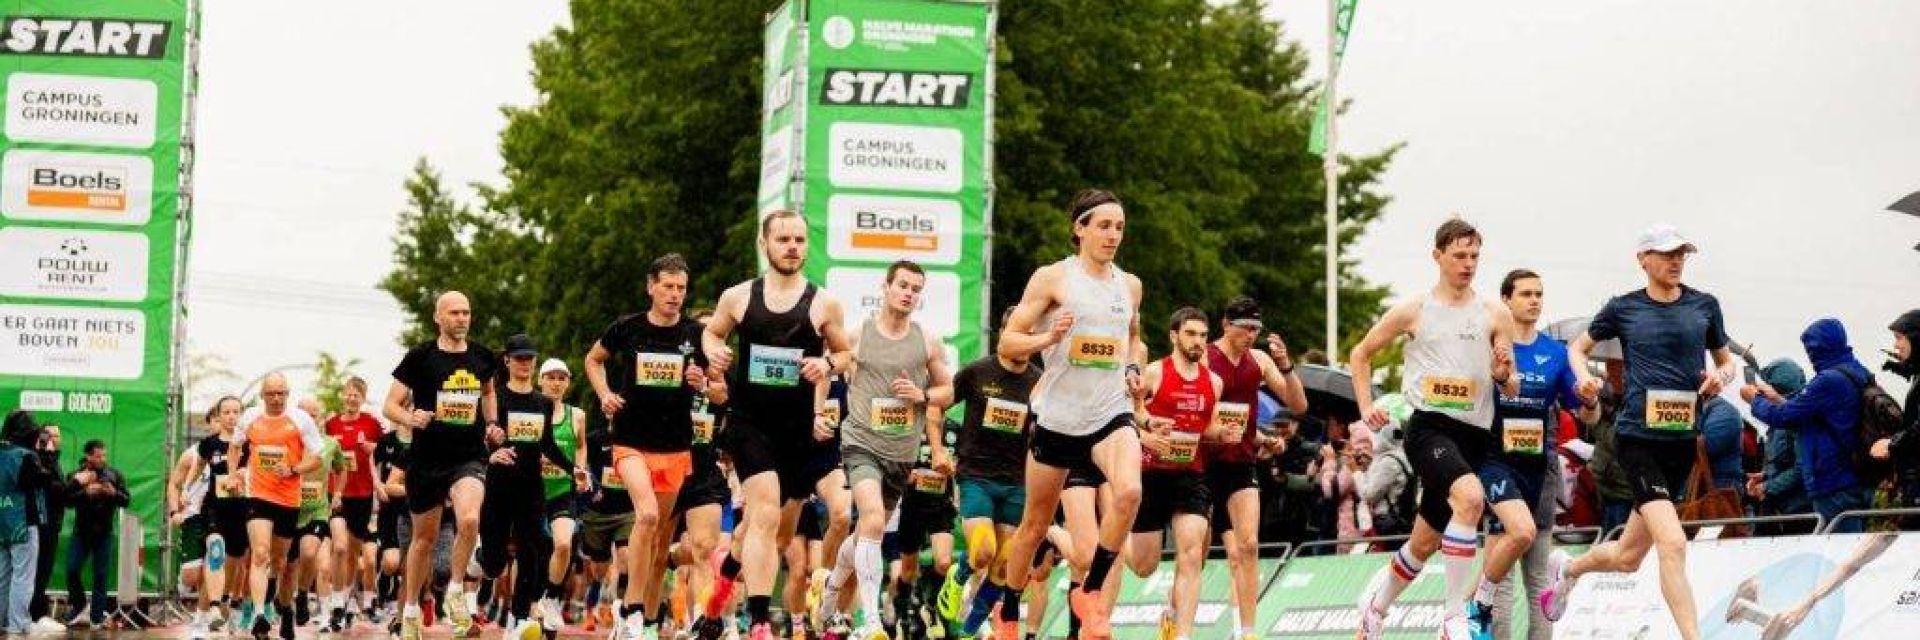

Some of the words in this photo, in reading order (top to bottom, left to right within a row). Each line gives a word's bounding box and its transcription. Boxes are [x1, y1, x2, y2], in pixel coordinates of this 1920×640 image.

[6, 18, 164, 55] START
[827, 71, 967, 105] START
[22, 90, 103, 107] CAMPUS
[22, 106, 138, 127] GRONINGEN
[842, 138, 914, 153] CAMPUS
[843, 153, 946, 171] GRONINGEN
[33, 168, 121, 190] Boels
[855, 211, 934, 232] Boels
[38, 258, 108, 273] POUW
[48, 273, 95, 285] RENT
[4, 315, 27, 330] ER
[33, 317, 79, 331] GAAT
[85, 320, 135, 334] NIETS
[18, 333, 78, 348] BOVEN
[1081, 342, 1115, 356] 8533
[643, 361, 676, 370] KLAAS
[765, 366, 785, 379] 58
[644, 371, 675, 380] 7023
[1432, 382, 1469, 397] 8532
[1655, 401, 1692, 410] EDWIN
[1655, 410, 1692, 423] 7002
